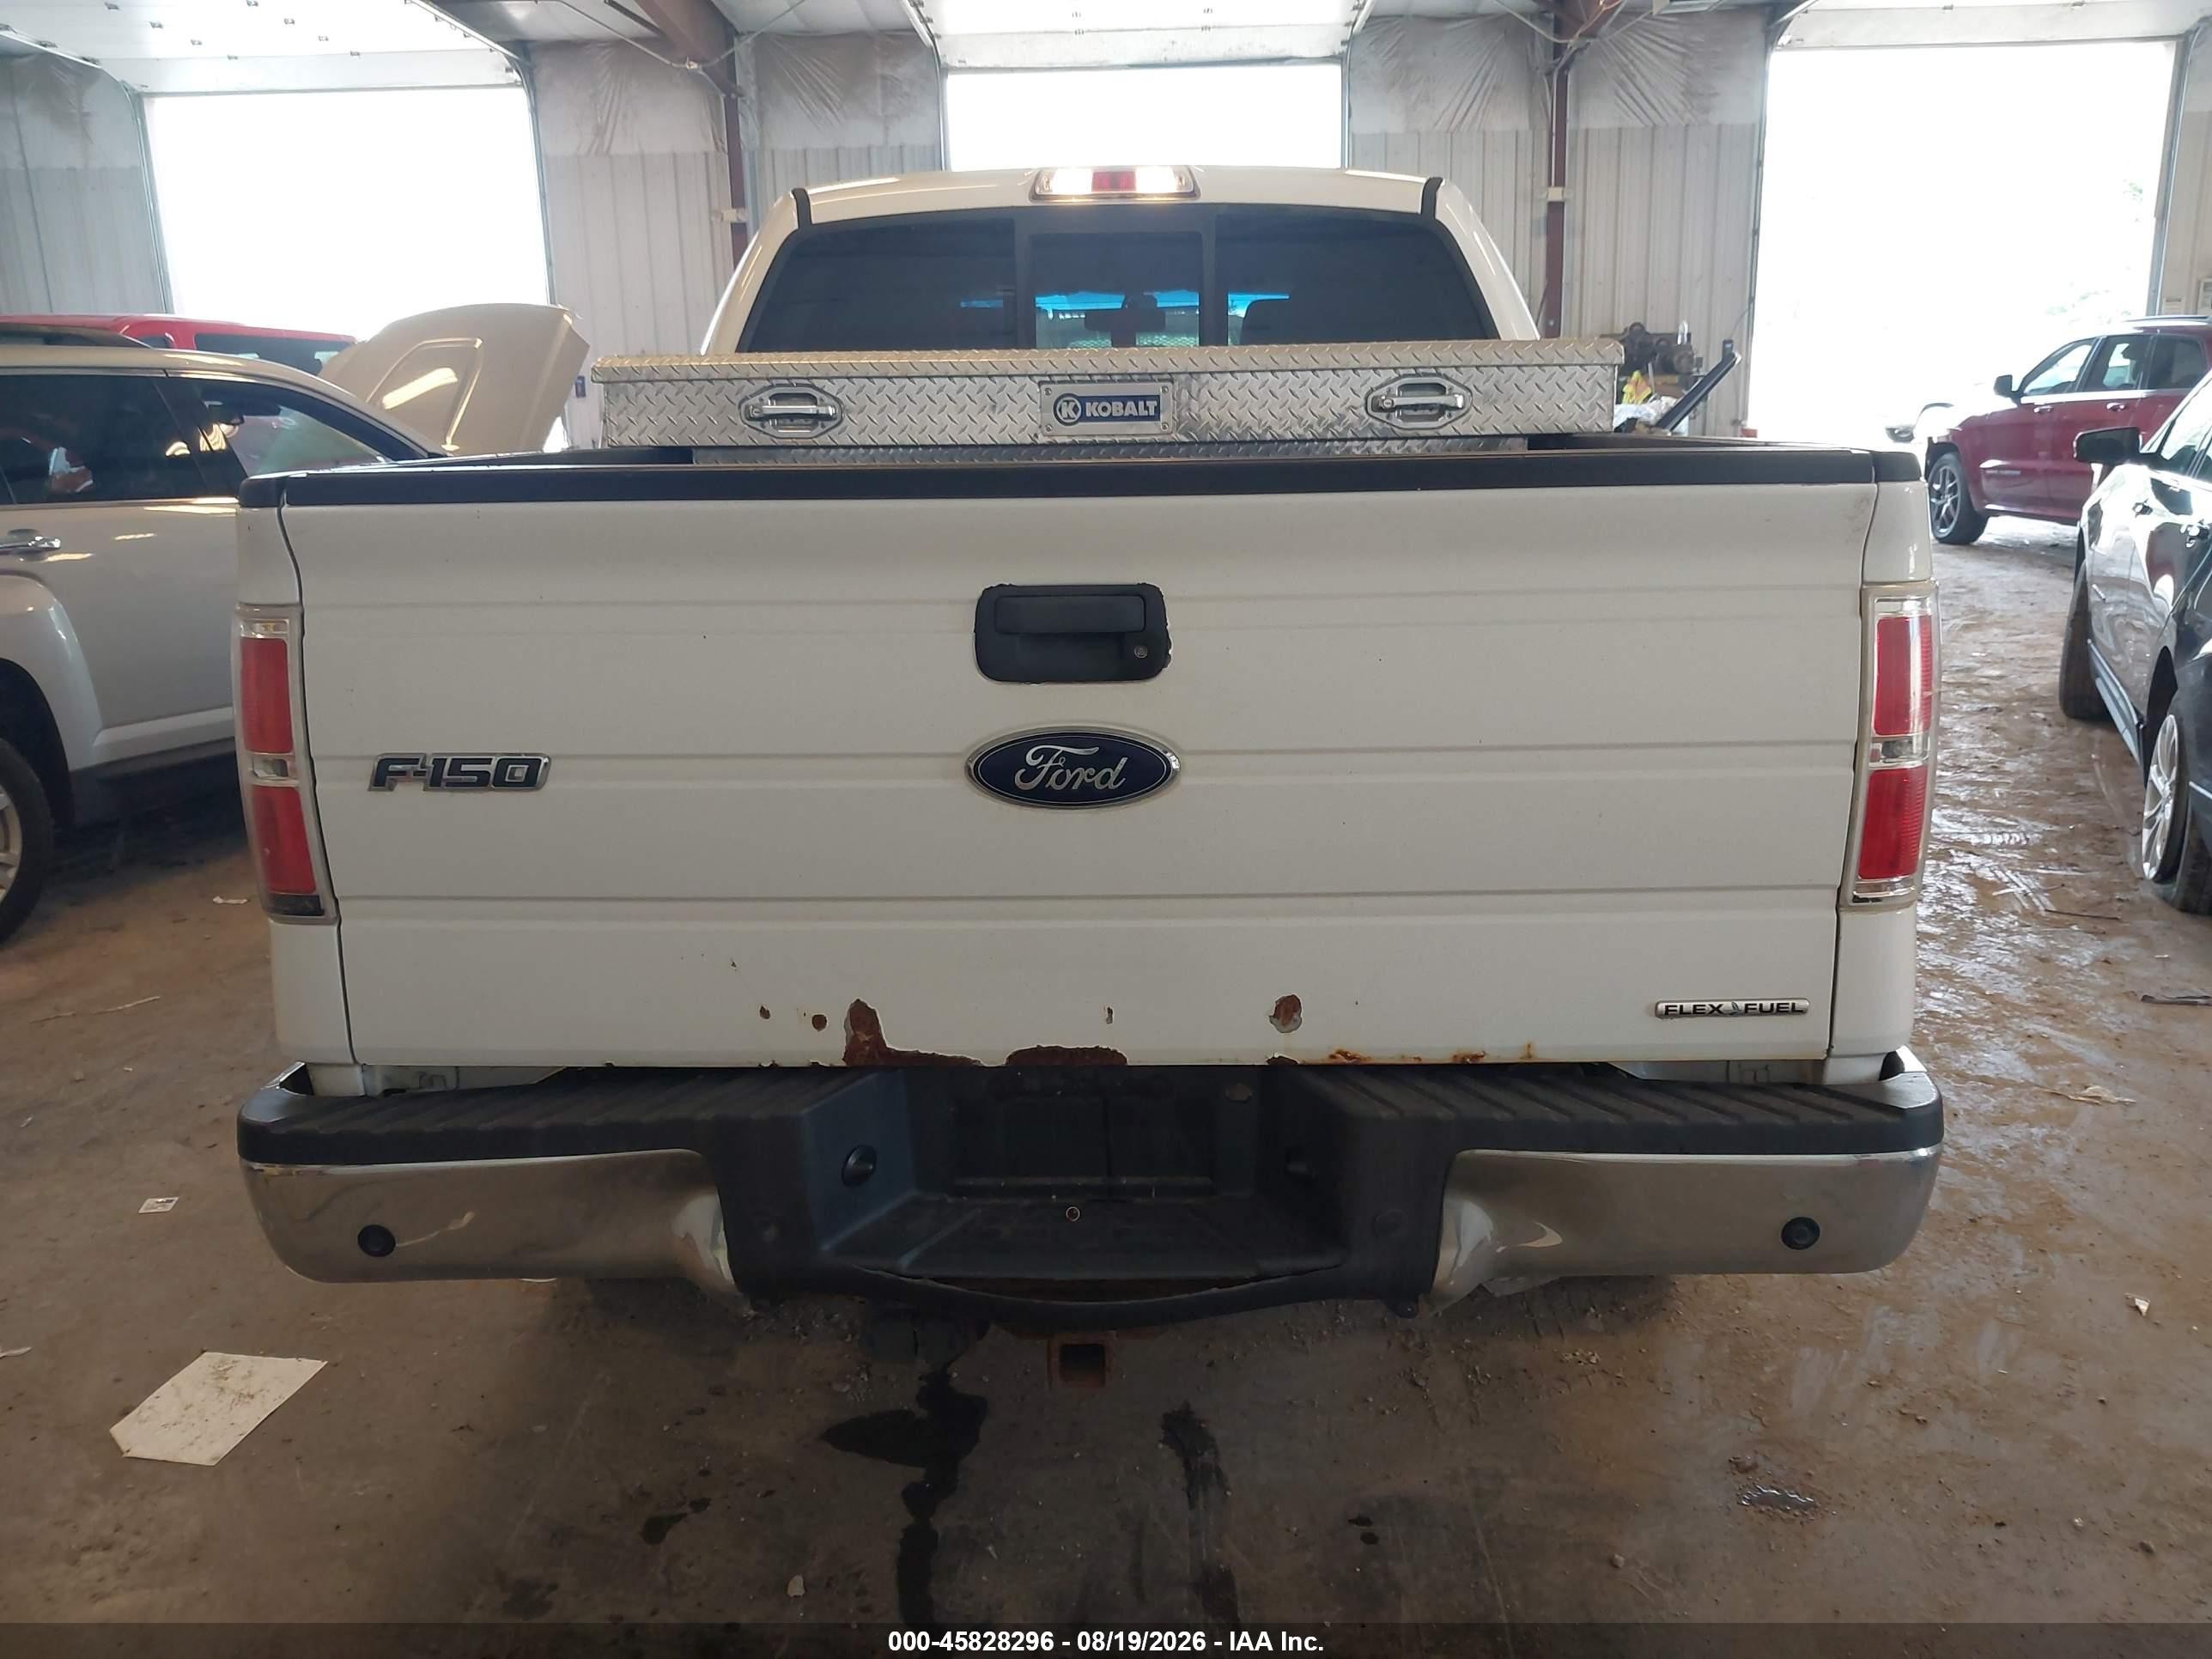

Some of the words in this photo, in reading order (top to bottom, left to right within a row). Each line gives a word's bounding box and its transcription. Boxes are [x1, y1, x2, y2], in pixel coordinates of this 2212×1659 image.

[1085, 400, 1158, 417] KOBALT
[368, 753, 552, 792] F-150
[1014, 744, 1129, 791] Ford
[1663, 1003, 1725, 1016] FLEX
[1743, 1002, 1804, 1014] FUEL
